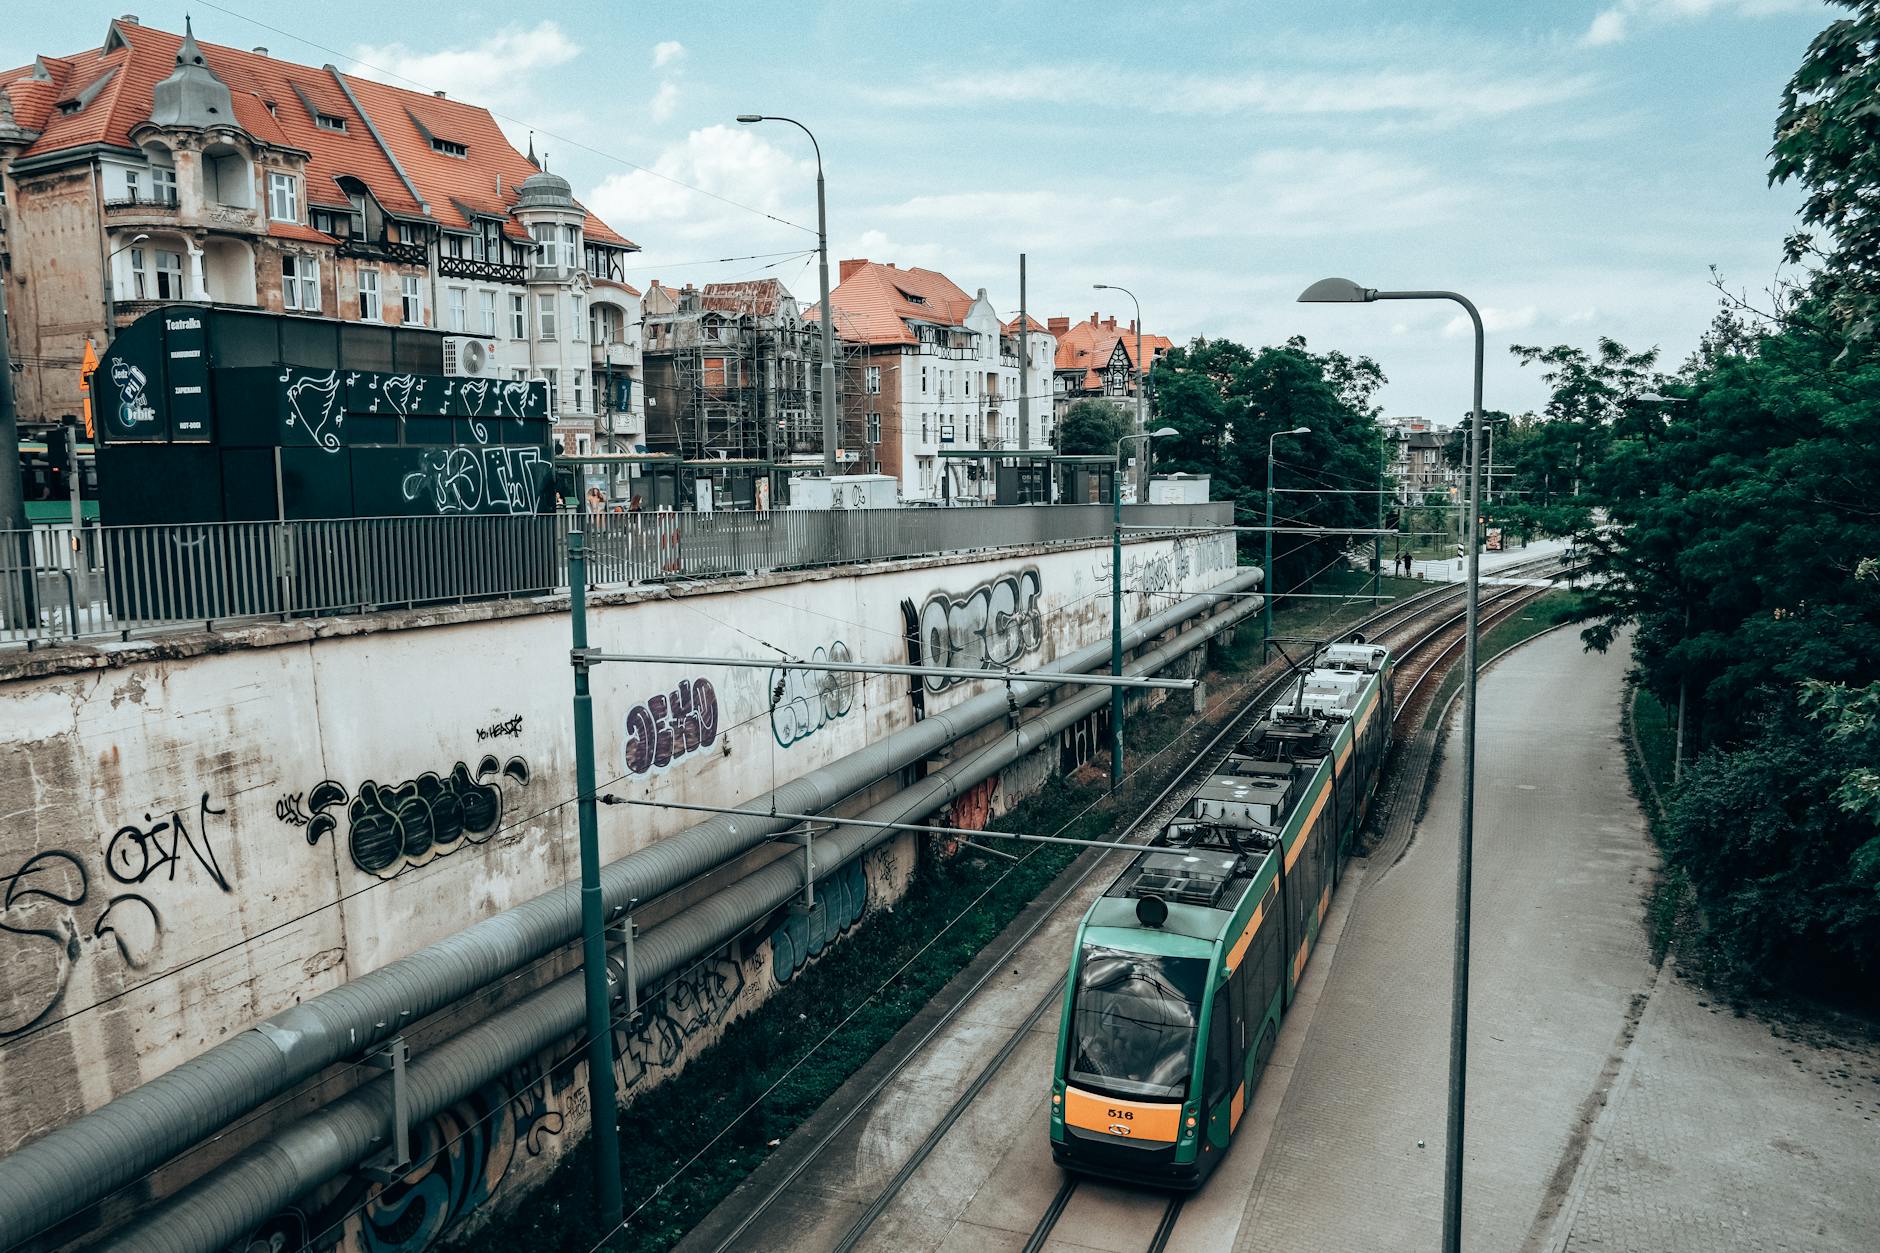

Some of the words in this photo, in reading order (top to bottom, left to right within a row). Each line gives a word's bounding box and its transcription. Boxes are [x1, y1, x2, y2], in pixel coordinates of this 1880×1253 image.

[166, 318, 201, 330] Teatralka
[114, 369, 129, 379] Jedz
[124, 378, 140, 399] Pij
[125, 405, 155, 421] Orbit
[1107, 1108, 1134, 1120] 516
